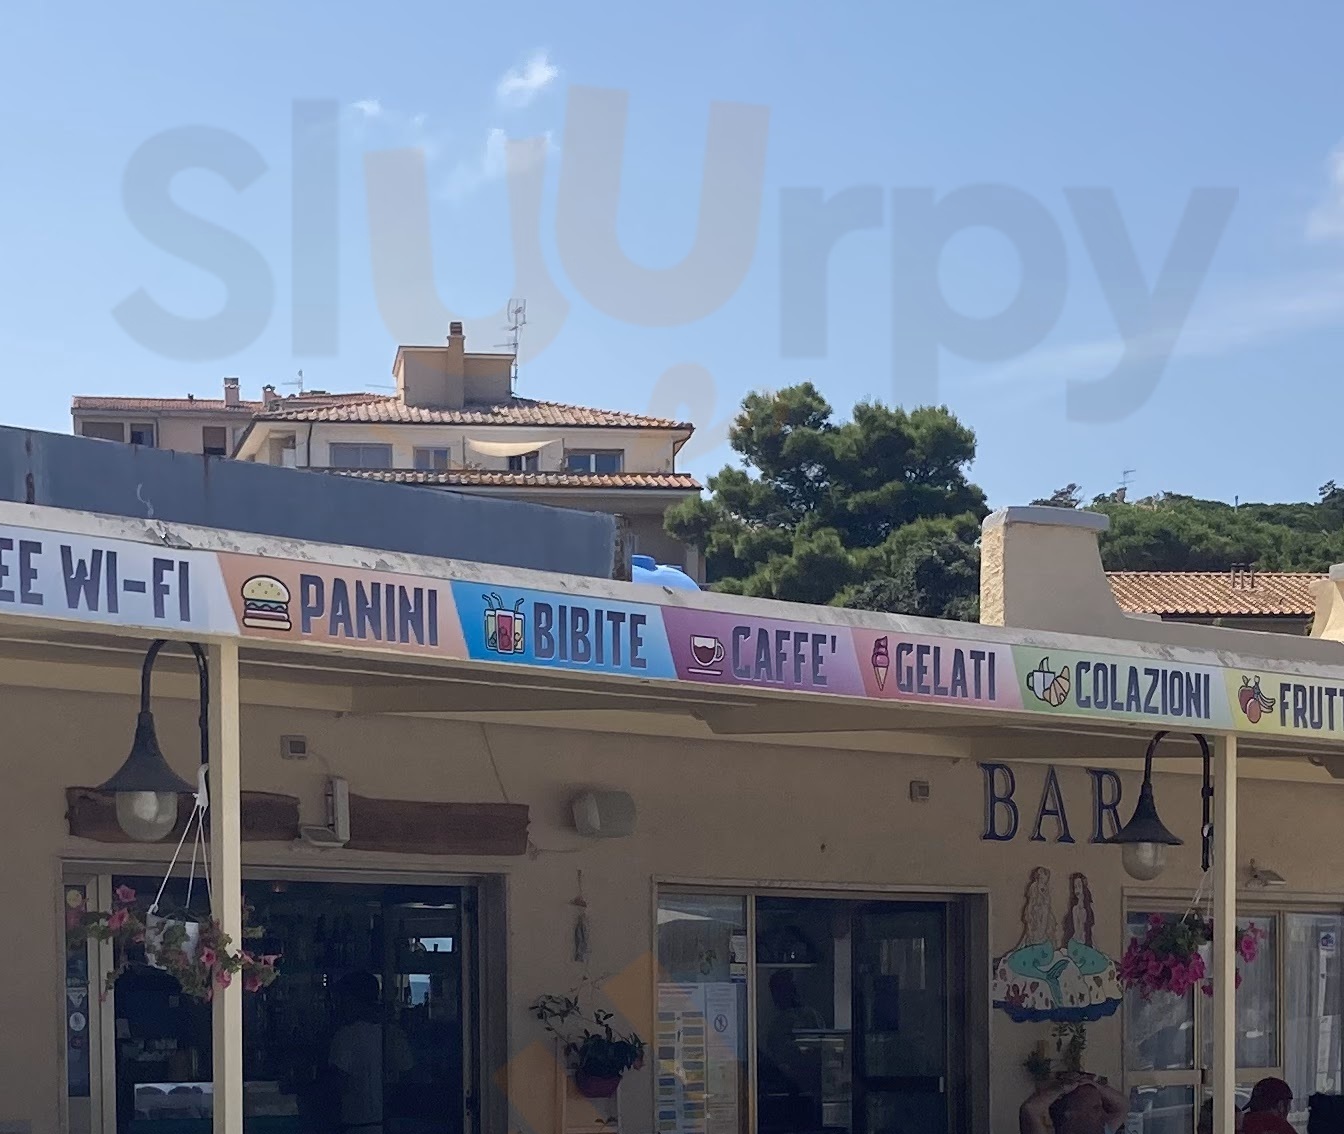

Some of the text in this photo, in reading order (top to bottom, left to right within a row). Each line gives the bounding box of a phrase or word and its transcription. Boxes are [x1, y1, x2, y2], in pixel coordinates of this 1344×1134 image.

[60, 545, 191, 622] WI-FI
[300, 573, 439, 647] PANINI
[534, 602, 648, 669] BIBITE
[731, 626, 837, 686] CAFFE'
[896, 643, 996, 701] GELATI
[1075, 661, 1211, 720] COLAZIONI
[977, 761, 1124, 844] BAR
